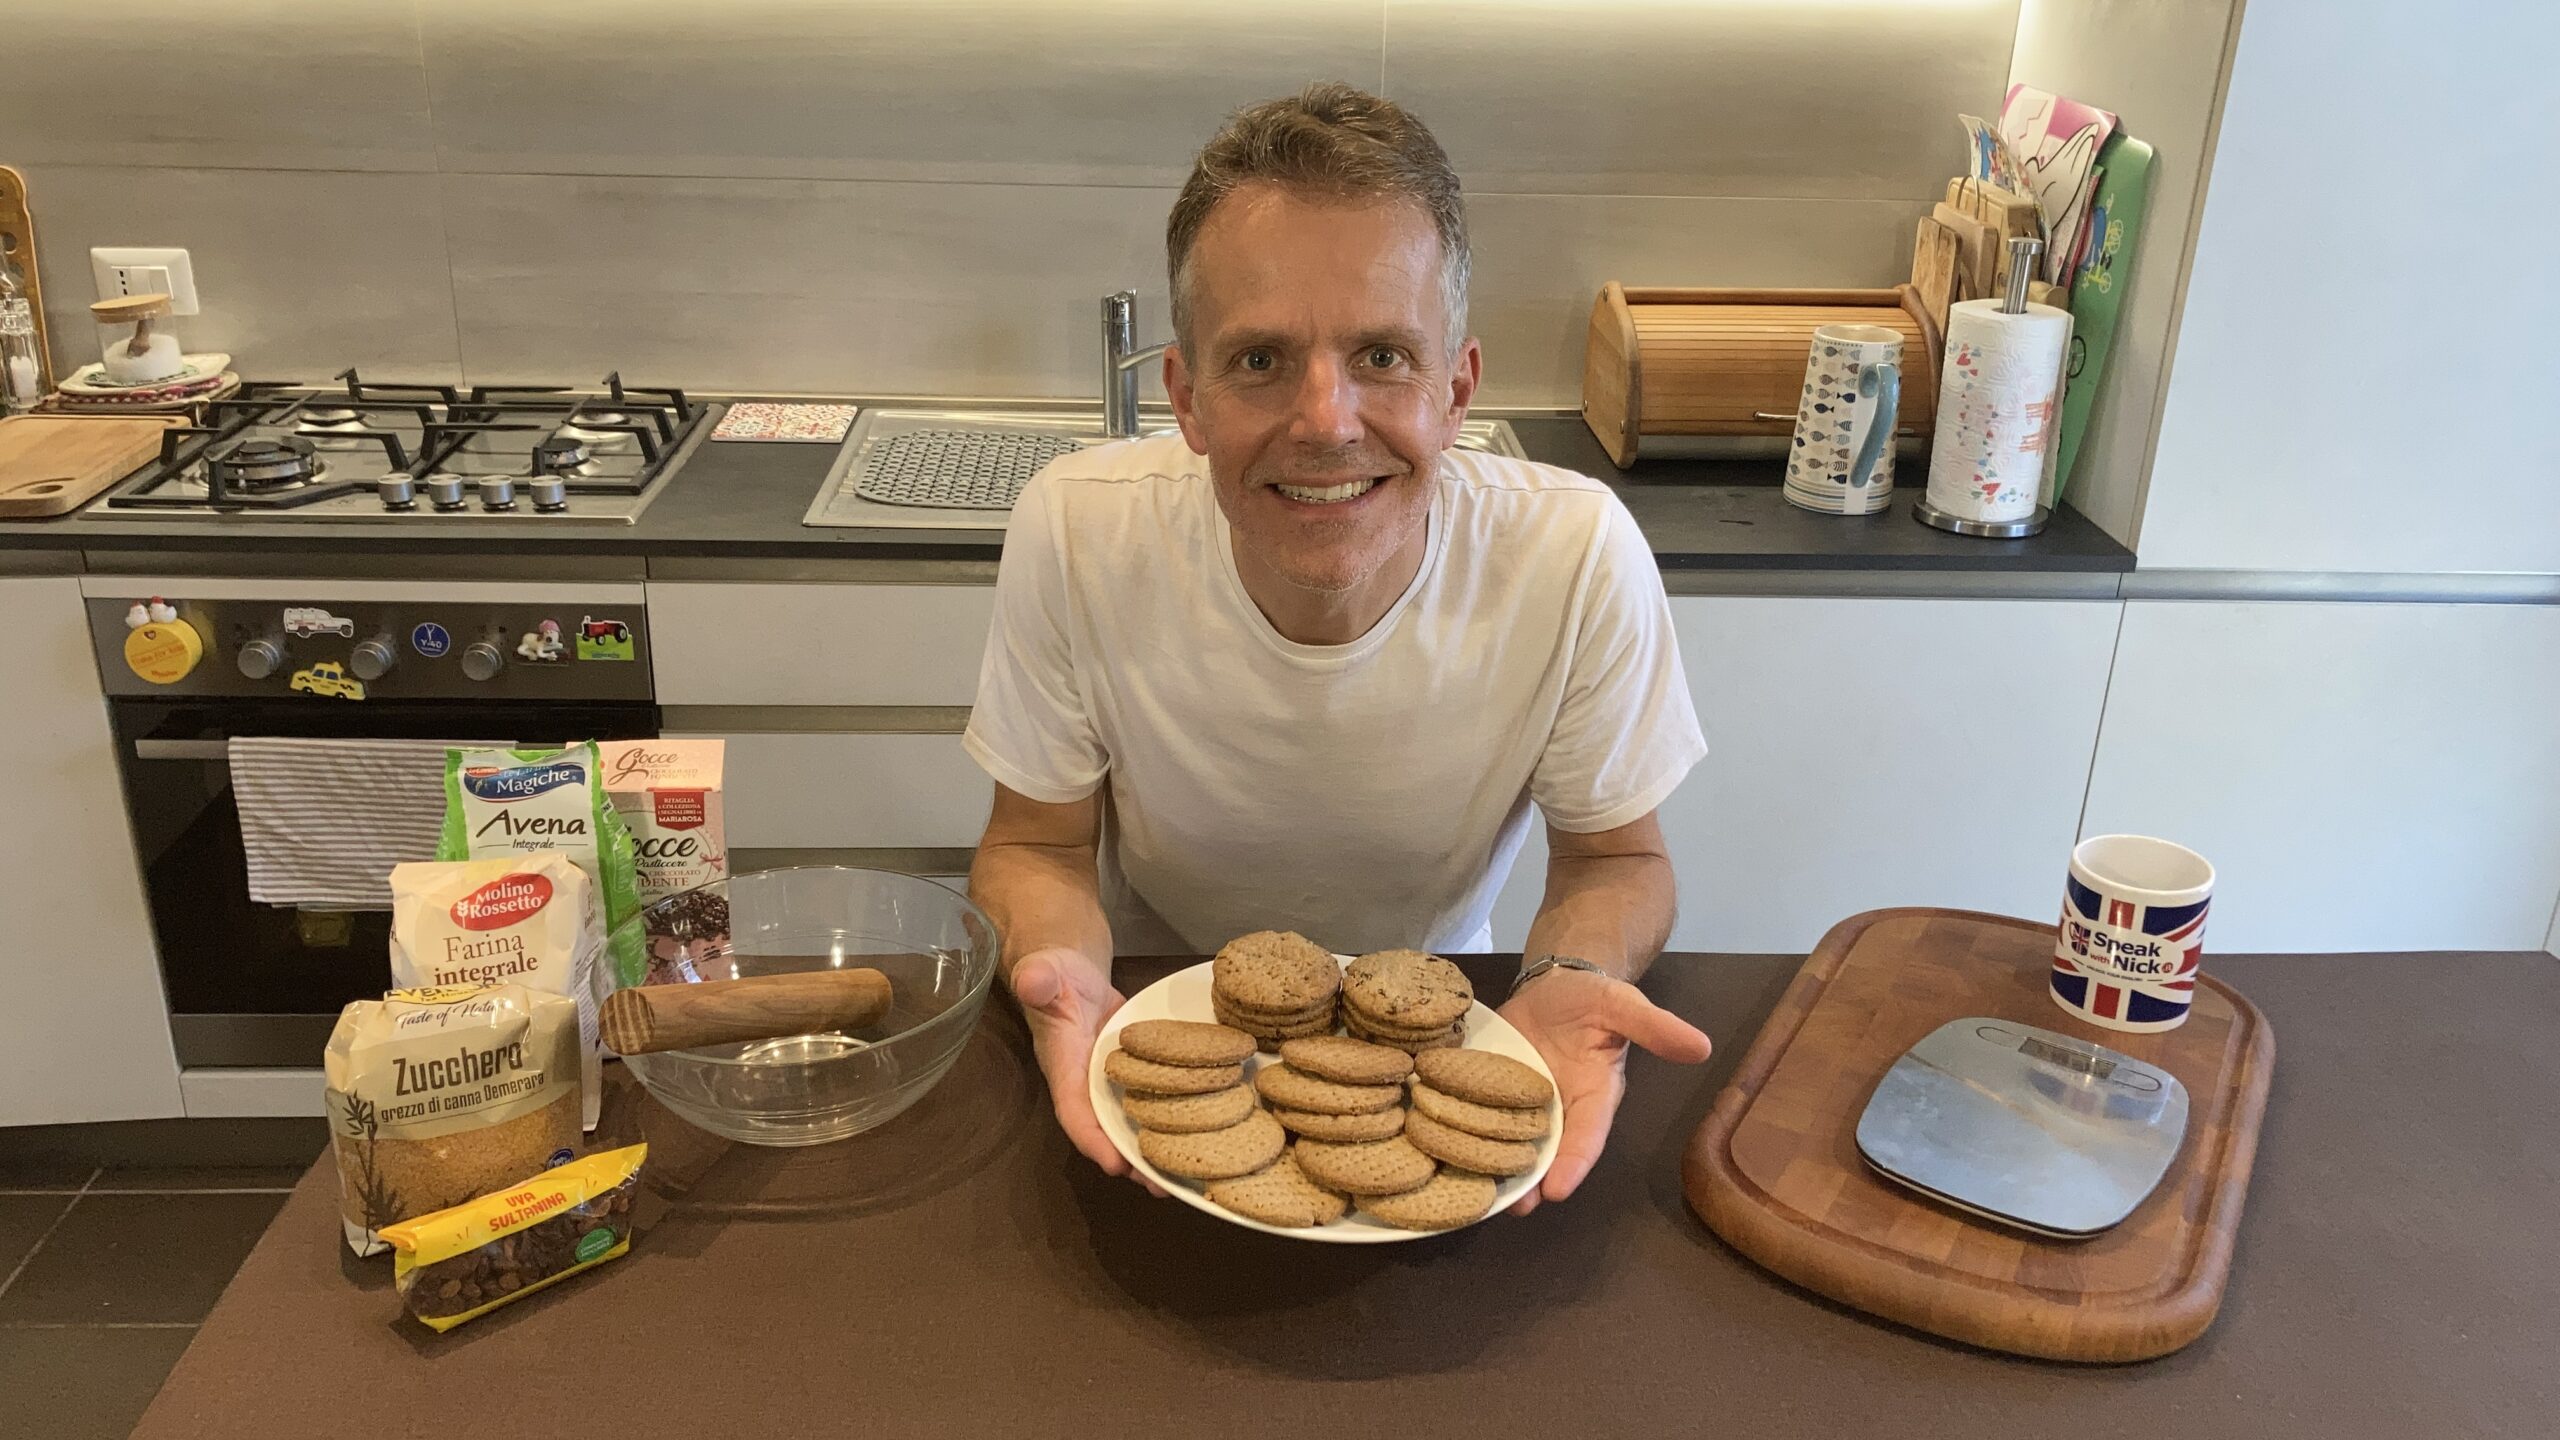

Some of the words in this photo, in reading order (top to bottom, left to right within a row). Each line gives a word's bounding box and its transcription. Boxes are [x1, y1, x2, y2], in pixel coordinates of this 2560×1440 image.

[608, 747, 679, 786] Gocce
[496, 769, 570, 794] Magiche
[475, 808, 587, 838] Avena
[658, 815, 703, 824] MARIAROSA
[511, 837, 555, 852] Integrale
[631, 836, 699, 858] occe
[474, 882, 535, 906] Molino
[469, 896, 543, 920] Rossetto
[442, 932, 525, 963] Farina
[2093, 932, 2162, 957] Speak
[433, 950, 539, 986] integrale
[2090, 953, 2110, 965] with
[2113, 955, 2161, 974] Nick
[396, 1009, 433, 1029] Taste
[436, 1006, 452, 1027] of
[392, 1040, 524, 1097] Zucchero
[381, 1102, 426, 1124] grezzo
[428, 1097, 442, 1115] di
[443, 1092, 483, 1111] canna
[484, 1071, 545, 1102] Demerara
[489, 1192, 568, 1232] SULTANINA
[505, 1191, 537, 1208] UVA
